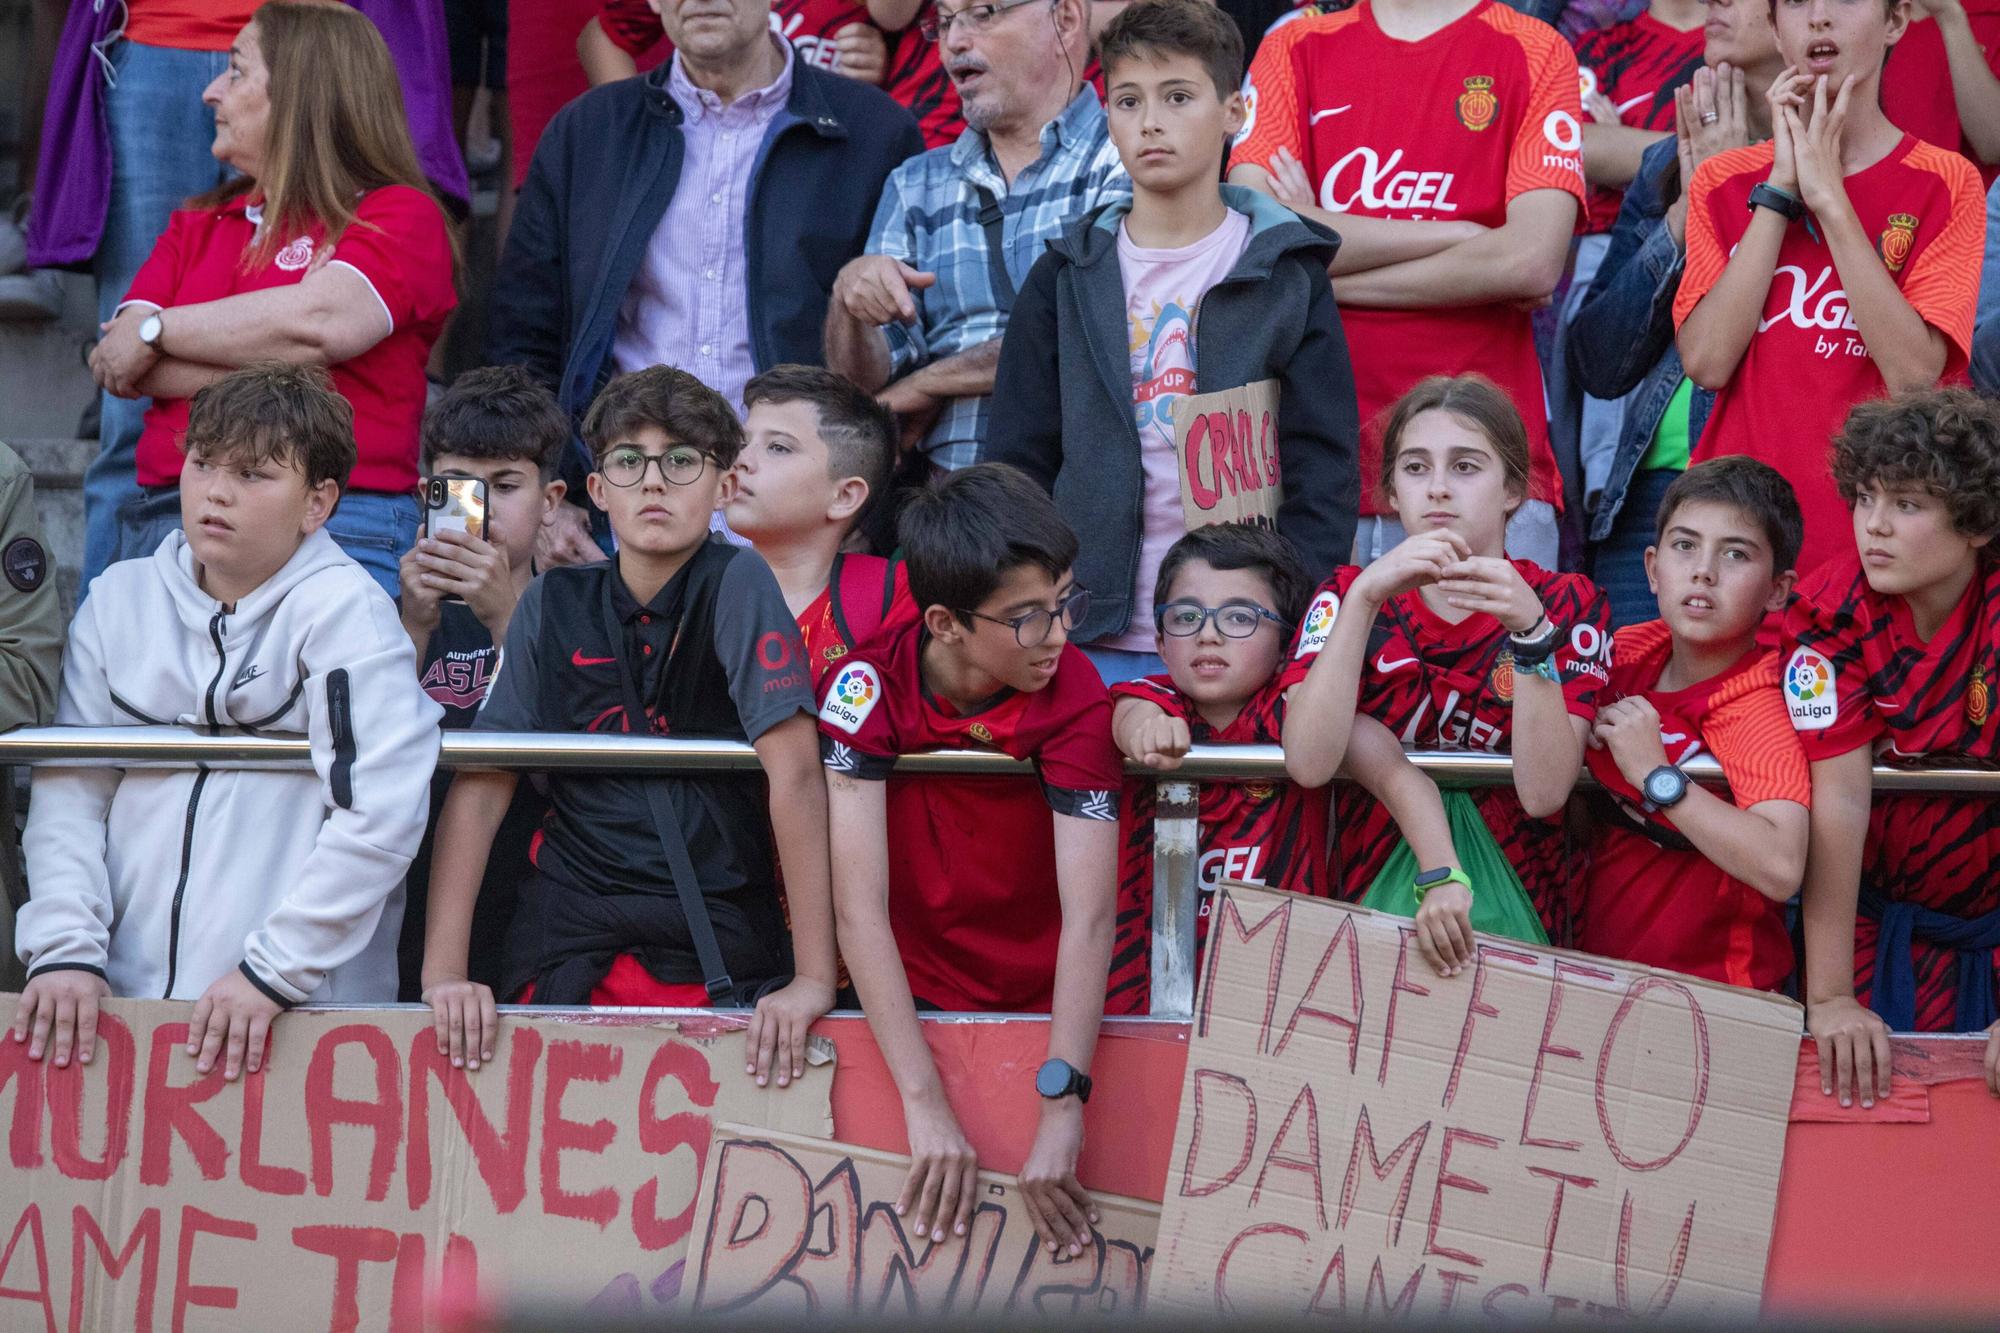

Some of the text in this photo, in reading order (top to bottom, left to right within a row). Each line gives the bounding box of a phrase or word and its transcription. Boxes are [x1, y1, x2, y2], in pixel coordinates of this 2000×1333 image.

[1814, 334, 1839, 359] by
[1163, 374, 1185, 387] UP
[1571, 623, 1614, 668] OK
[1566, 659, 1609, 686] mobility
[826, 701, 858, 724] LaLiga
[1199, 889, 1711, 1172] MAFFEO
[1180, 1068, 1505, 1269] DAME
